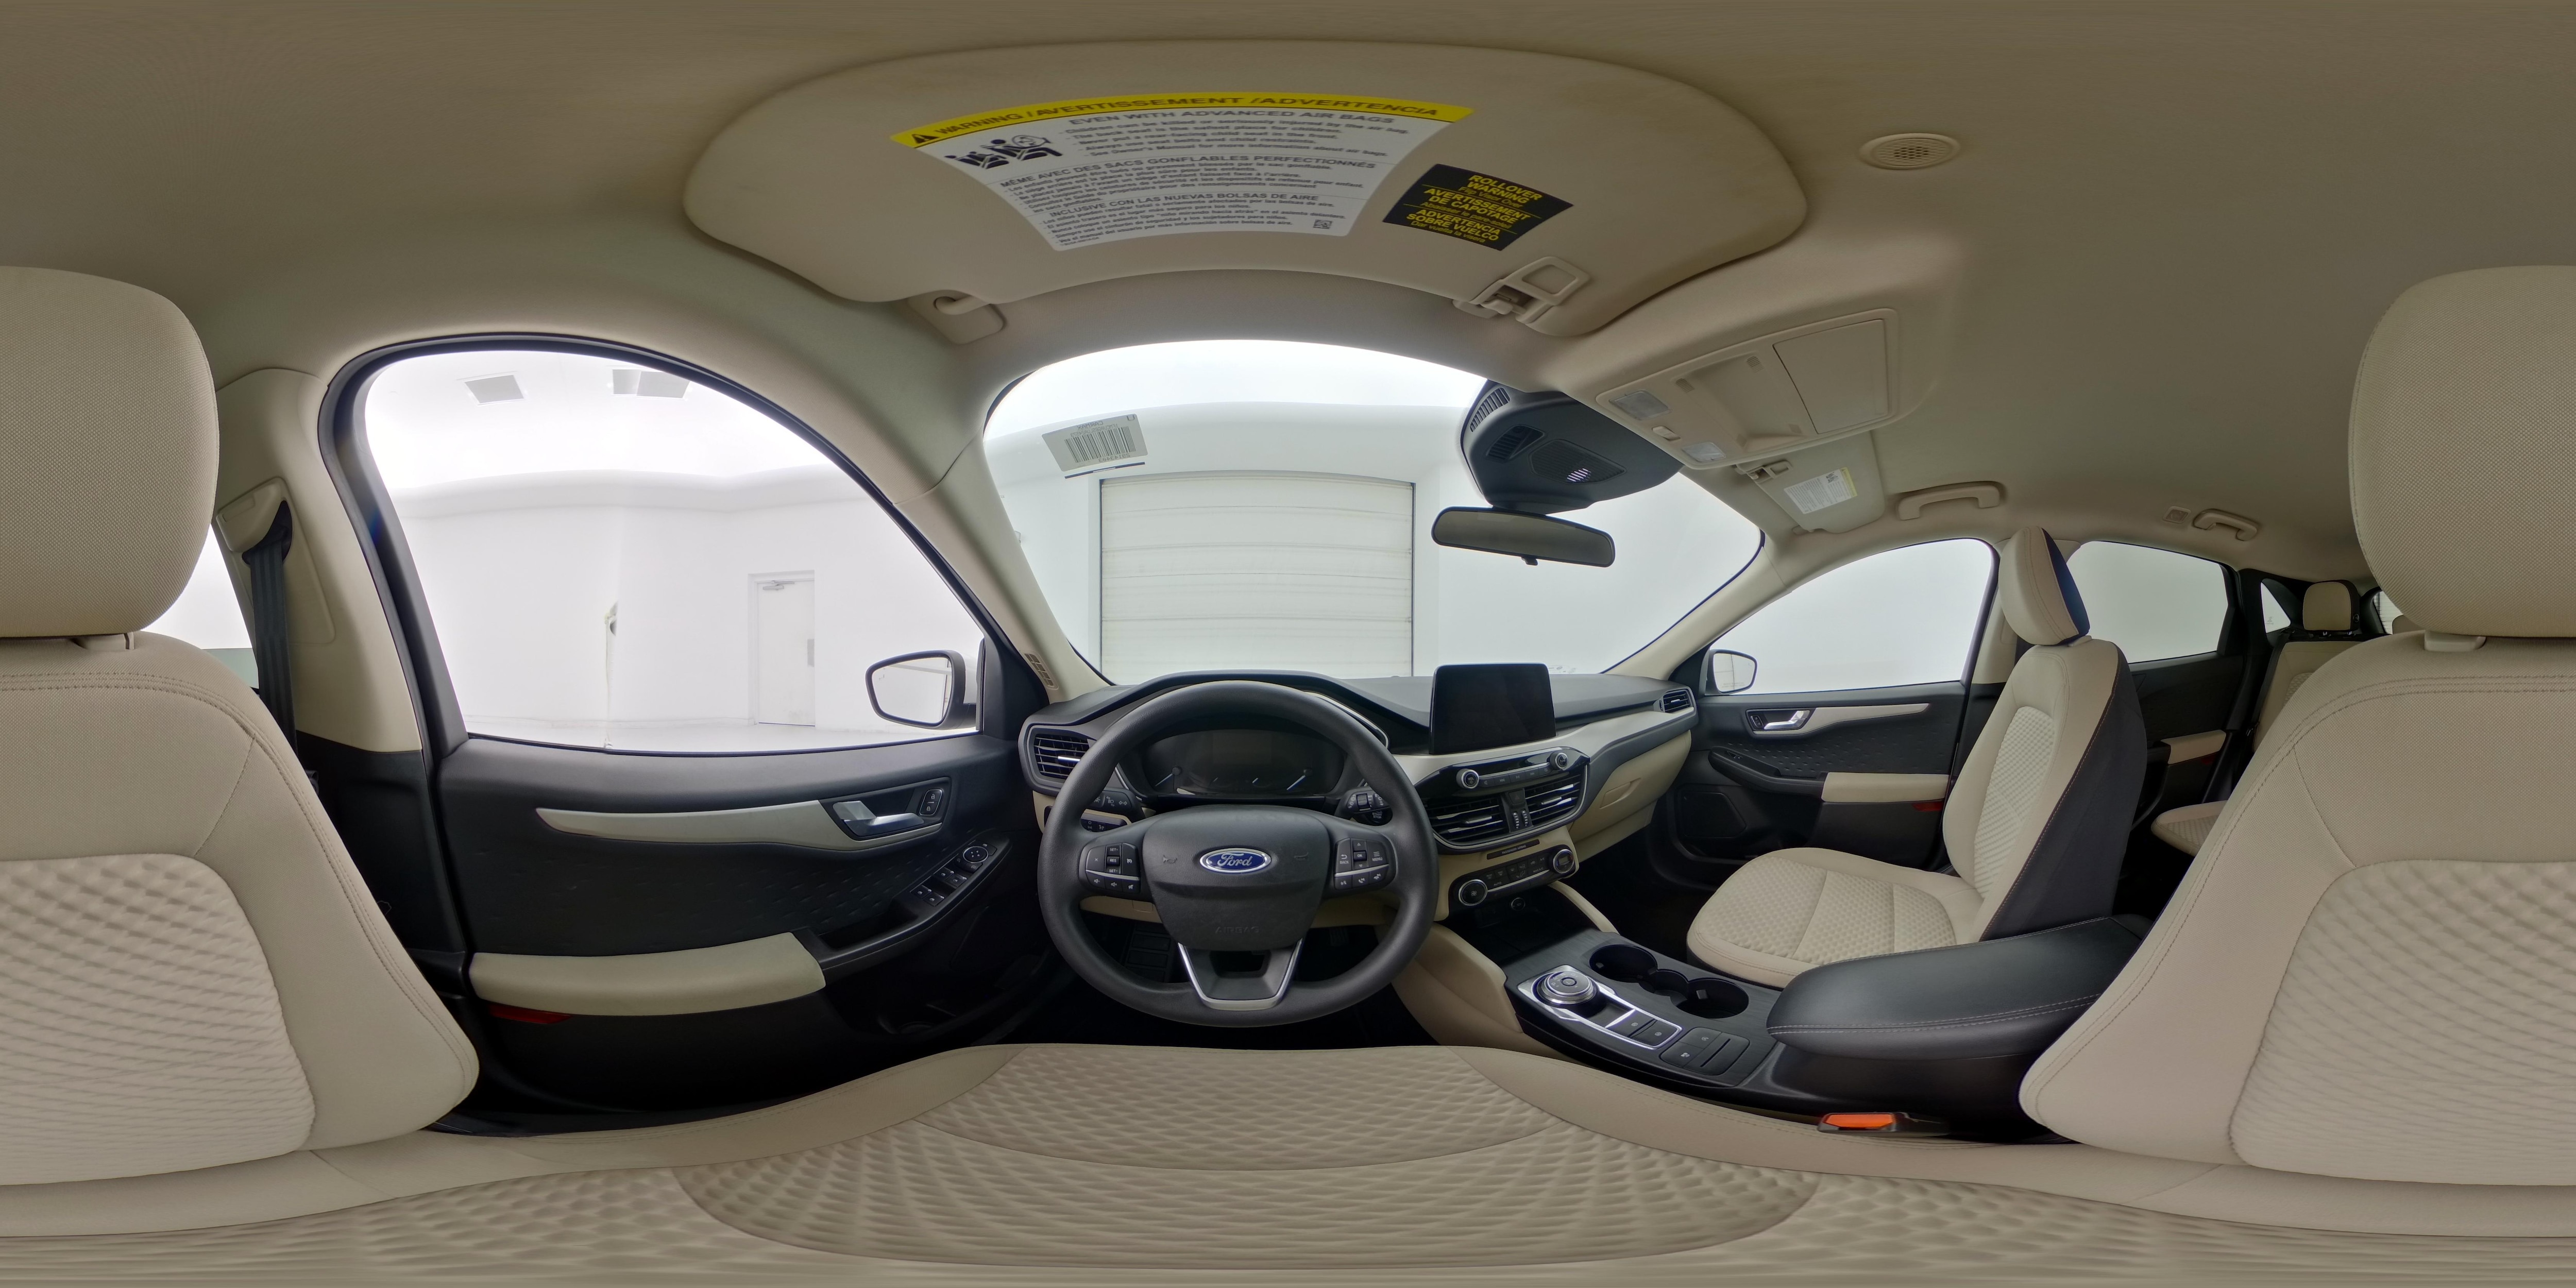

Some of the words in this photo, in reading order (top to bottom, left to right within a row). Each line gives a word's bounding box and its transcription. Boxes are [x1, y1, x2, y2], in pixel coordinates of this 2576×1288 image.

[935, 113, 1024, 134] WARNING
[1069, 115, 1120, 125] EVEN
[1339, 114, 1395, 123] BAGS
[1000, 176, 1036, 187] MÊME
[1038, 169, 1071, 179] AVEC
[1073, 164, 1101, 173] DES
[1104, 160, 1144, 168] SACS
[1147, 156, 1249, 164] GONFLABLES
[1253, 156, 1376, 168] PERFECTIONNÉS
[1467, 181, 1530, 204] WARNING
[1468, 175, 1543, 200] ROLLOVER
[1049, 203, 1107, 217] INCLUSIVE
[1423, 189, 1531, 220] AVERTISSEMENT
[1428, 196, 1450, 205] DE
[1451, 201, 1518, 224] CAPOTAGE
[1479, 191, 1502, 201] Visor
[1501, 199, 1523, 208] Over
[1406, 213, 1452, 228] SOBRE
[1453, 224, 1499, 241] VUELCO
[1415, 209, 1500, 235] ADVERTENCIA
[1429, 225, 1453, 234] vuelta
[1463, 234, 1486, 243] visera
[1217, 853, 1253, 866] Ford
